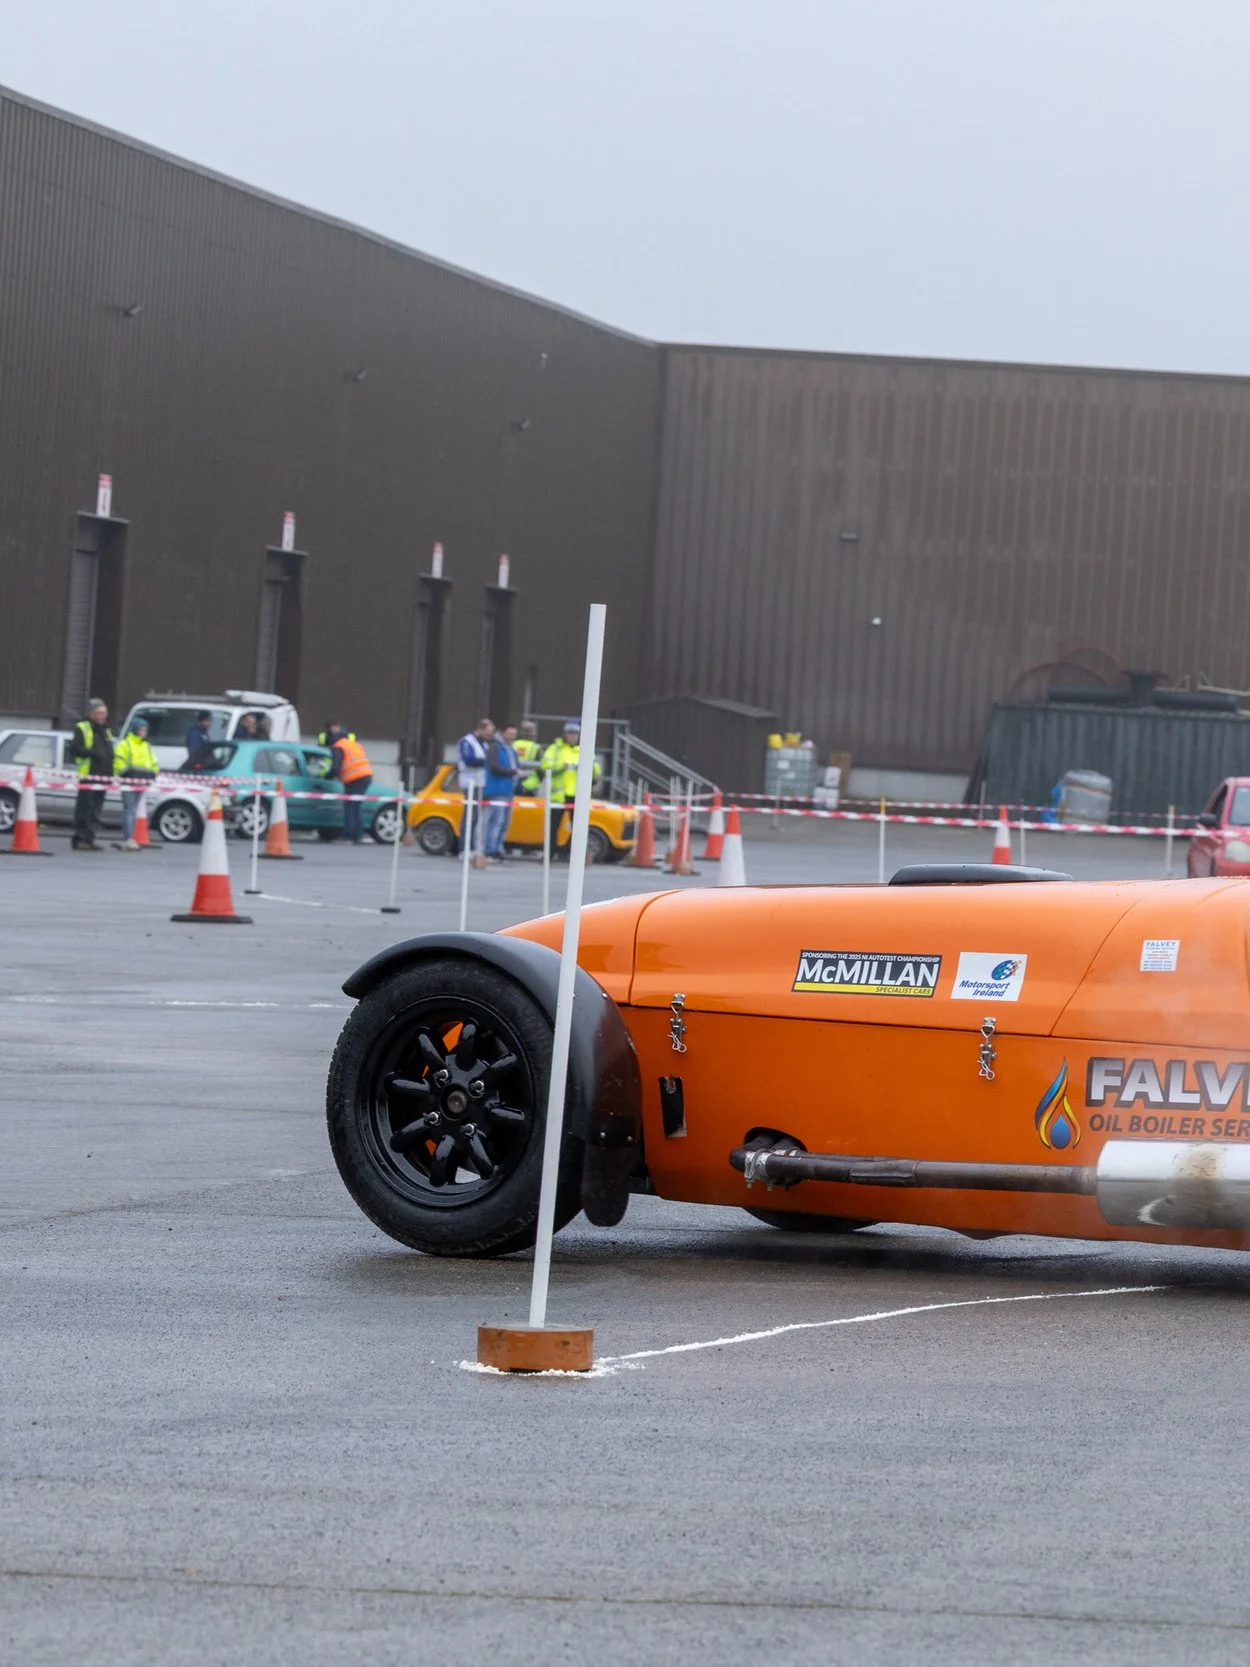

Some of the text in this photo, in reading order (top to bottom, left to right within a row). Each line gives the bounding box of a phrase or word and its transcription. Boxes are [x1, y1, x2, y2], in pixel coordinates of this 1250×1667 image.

[801, 951, 837, 960] SPONSORING
[868, 954, 897, 962] AUTOTEST
[896, 955, 941, 964] CHAMPIONSHIP
[796, 958, 940, 988] McMILLAN
[875, 985, 932, 996] SPECIALIST CARS
[959, 980, 1010, 990] Motorsport
[972, 989, 1007, 998] Ireland
[1088, 1113, 1123, 1133] OIL
[1128, 1115, 1206, 1136] BOILER
